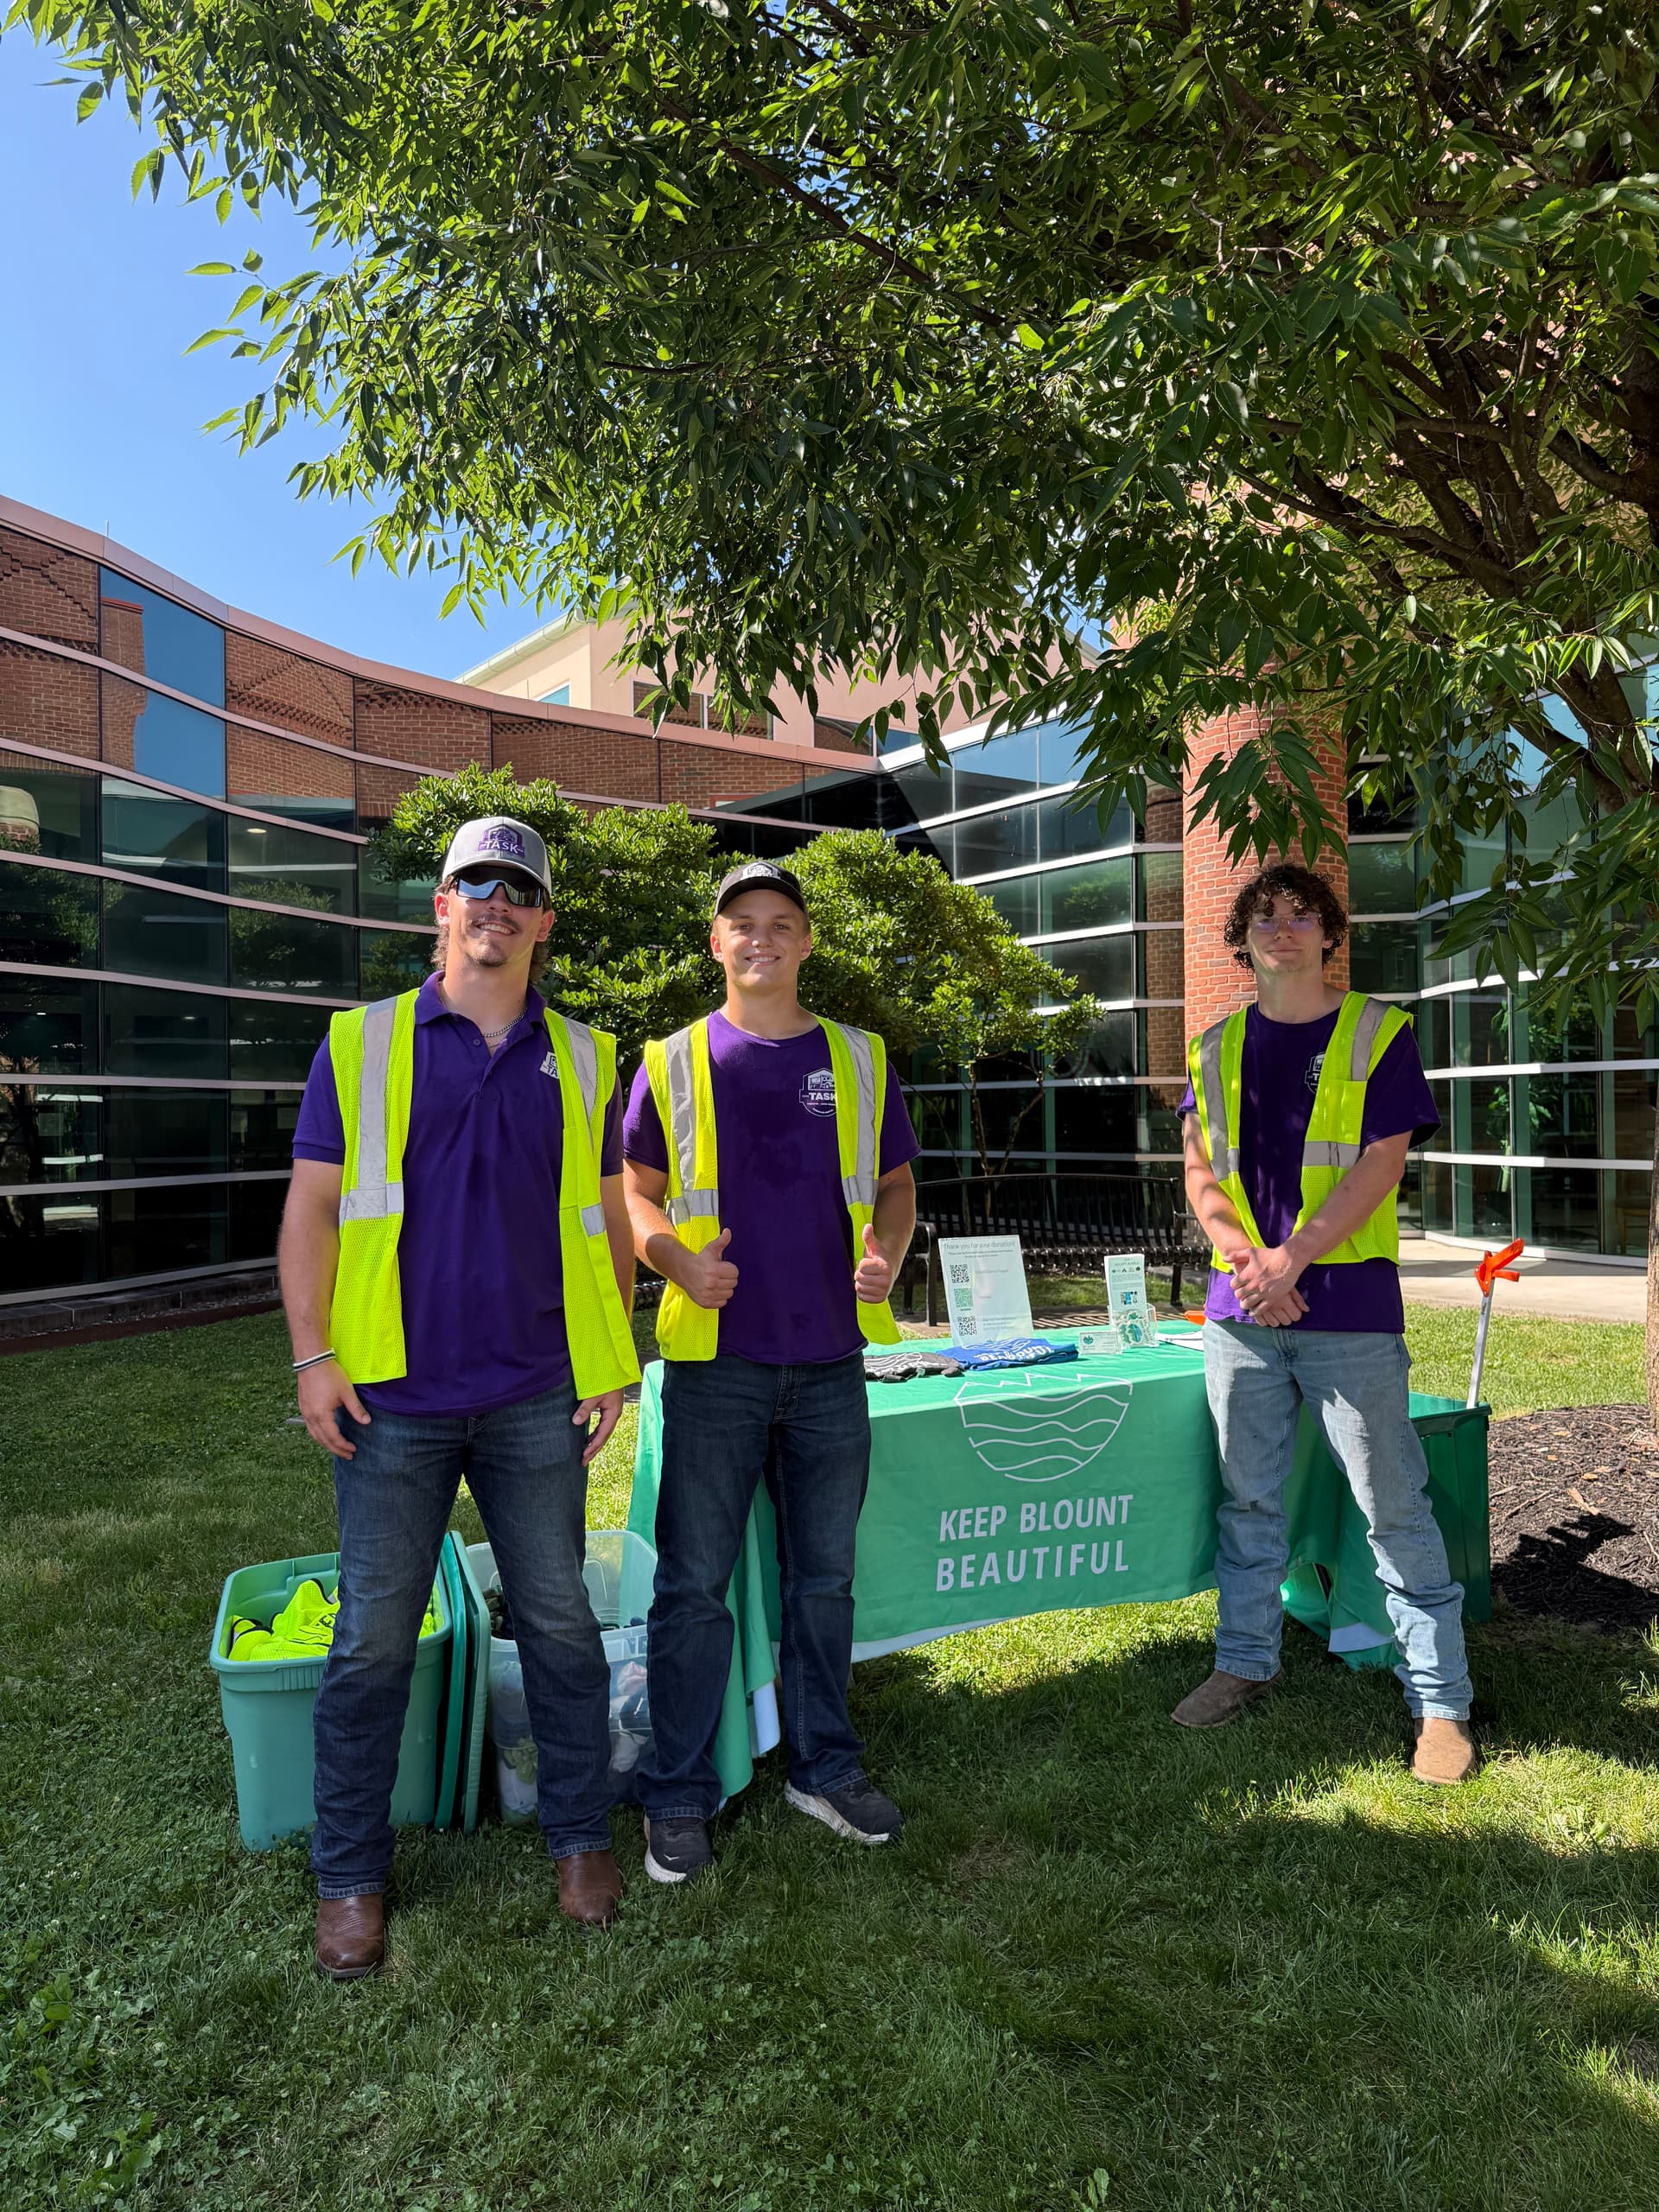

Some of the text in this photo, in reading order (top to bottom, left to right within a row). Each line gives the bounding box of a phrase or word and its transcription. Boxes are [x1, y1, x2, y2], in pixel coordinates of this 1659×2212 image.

[485, 841, 518, 854] TASK
[939, 1494, 1133, 1541] KEEP BLOUNT
[936, 1540, 1128, 1592] BEAUTIFUL
